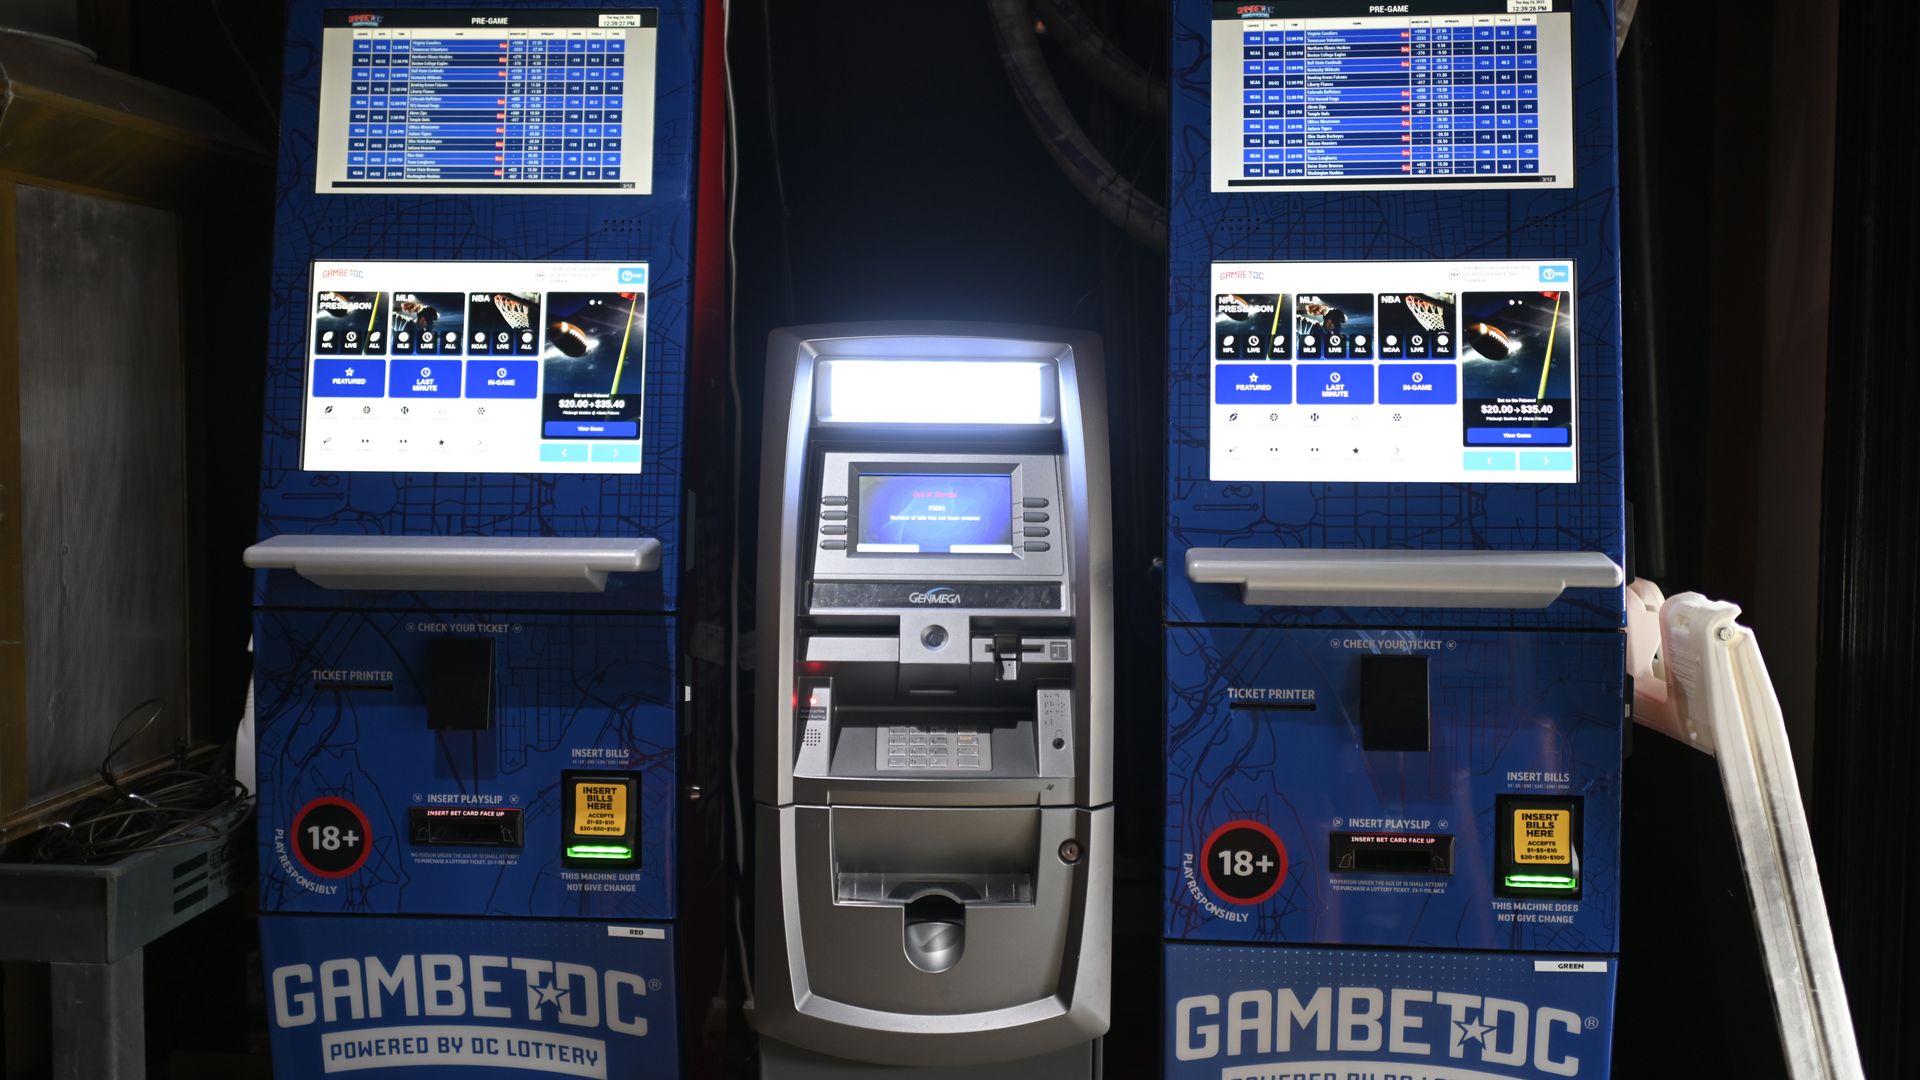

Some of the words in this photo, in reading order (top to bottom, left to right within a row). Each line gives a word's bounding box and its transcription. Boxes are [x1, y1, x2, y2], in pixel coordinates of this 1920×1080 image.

[1369, 5, 1409, 13] PRE-GAME
[472, 17, 508, 25] PRE-GAME
[472, 294, 490, 303] NBA
[1381, 296, 1401, 304] NBA
[558, 399, 588, 409] $20.00
[594, 399, 625, 409] $35.40
[1481, 404, 1514, 415] $20.00
[1520, 404, 1553, 415] $35.40
[909, 592, 961, 604] GENMEGA
[417, 623, 447, 632] CHECK
[450, 624, 476, 632] YOUR
[477, 624, 509, 633] TICKET
[1343, 639, 1376, 649] CHECK
[1378, 640, 1406, 649] YOUR
[1408, 640, 1443, 650] TICKET
[312, 670, 348, 681] TICKET
[350, 671, 393, 681] PRINTER
[1227, 688, 1266, 699] TICKET
[1268, 689, 1315, 700] PRINTER
[572, 748, 604, 758] INSERT
[606, 749, 629, 758] BILLS
[1507, 771, 1542, 781] INSERT
[1544, 772, 1570, 782] BILLS
[583, 787, 617, 795] INSERT
[427, 794, 460, 803] INSERT
[461, 794, 503, 804] PLAYSLIP
[1522, 813, 1559, 821] INSERT
[1349, 818, 1383, 828] INSERT
[1385, 819, 1431, 829] PLAYSLIP
[1526, 821, 1555, 829] BILLS
[307, 825, 359, 851] 18+
[1527, 829, 1554, 837] HERE
[275, 828, 286, 854] PLAY
[1183, 853, 1195, 880] PLAY
[1218, 850, 1274, 877] 18+
[279, 854, 337, 895] RESPONSIBLY
[561, 872, 579, 880] THIS
[580, 873, 617, 881] MACHINE
[619, 873, 640, 882] DOES
[567, 883, 582, 892] NOT
[584, 884, 602, 892] GIVE
[603, 884, 637, 893] CHANGE
[1187, 880, 1249, 922] RESPONSIBLY
[1492, 902, 1512, 910] THIS
[1513, 902, 1553, 911] MACHINE
[1555, 903, 1579, 912] DOES
[1498, 913, 1516, 922] NOT
[1517, 914, 1536, 923] GIVE
[1538, 915, 1574, 924] CHANGE
[272, 953, 649, 1037] GAMBETDC
[1176, 986, 1582, 1078] GAMBETDC
[330, 1037, 428, 1061] POWERED
[438, 1036, 464, 1054] BY
[472, 1037, 499, 1055] DC
[507, 1039, 599, 1067] LOTTERY
